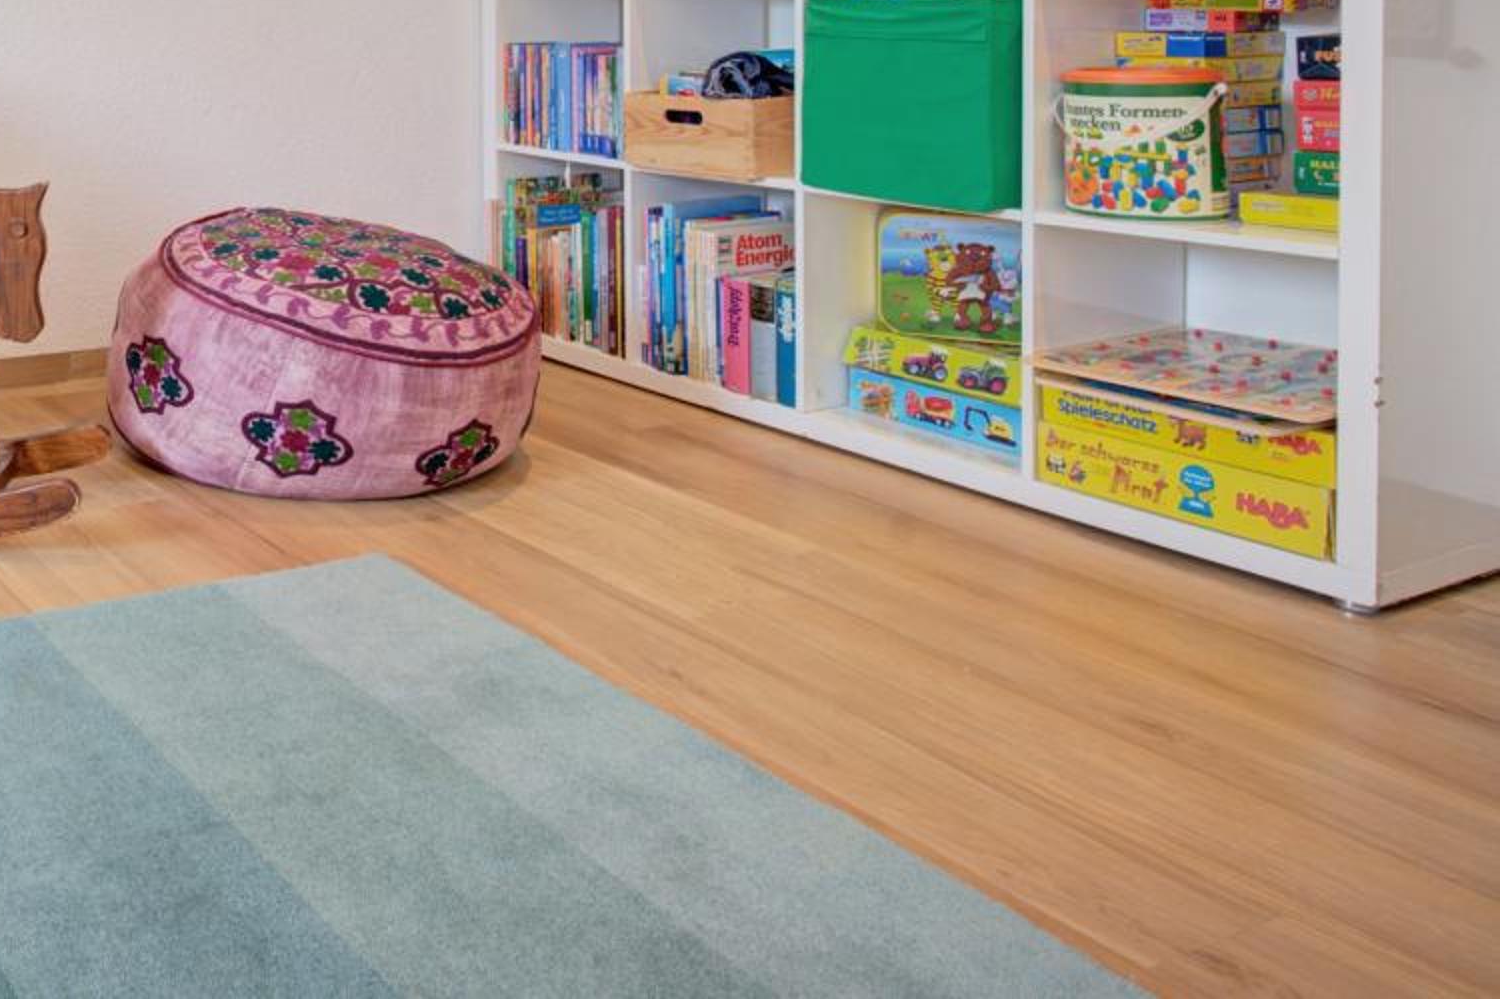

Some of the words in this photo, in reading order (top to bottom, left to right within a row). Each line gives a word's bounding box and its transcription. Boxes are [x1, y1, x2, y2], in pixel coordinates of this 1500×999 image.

[739, 233, 783, 250] Atom
[1059, 397, 1157, 433] Spieleschatz
[1235, 491, 1310, 530] HABA
